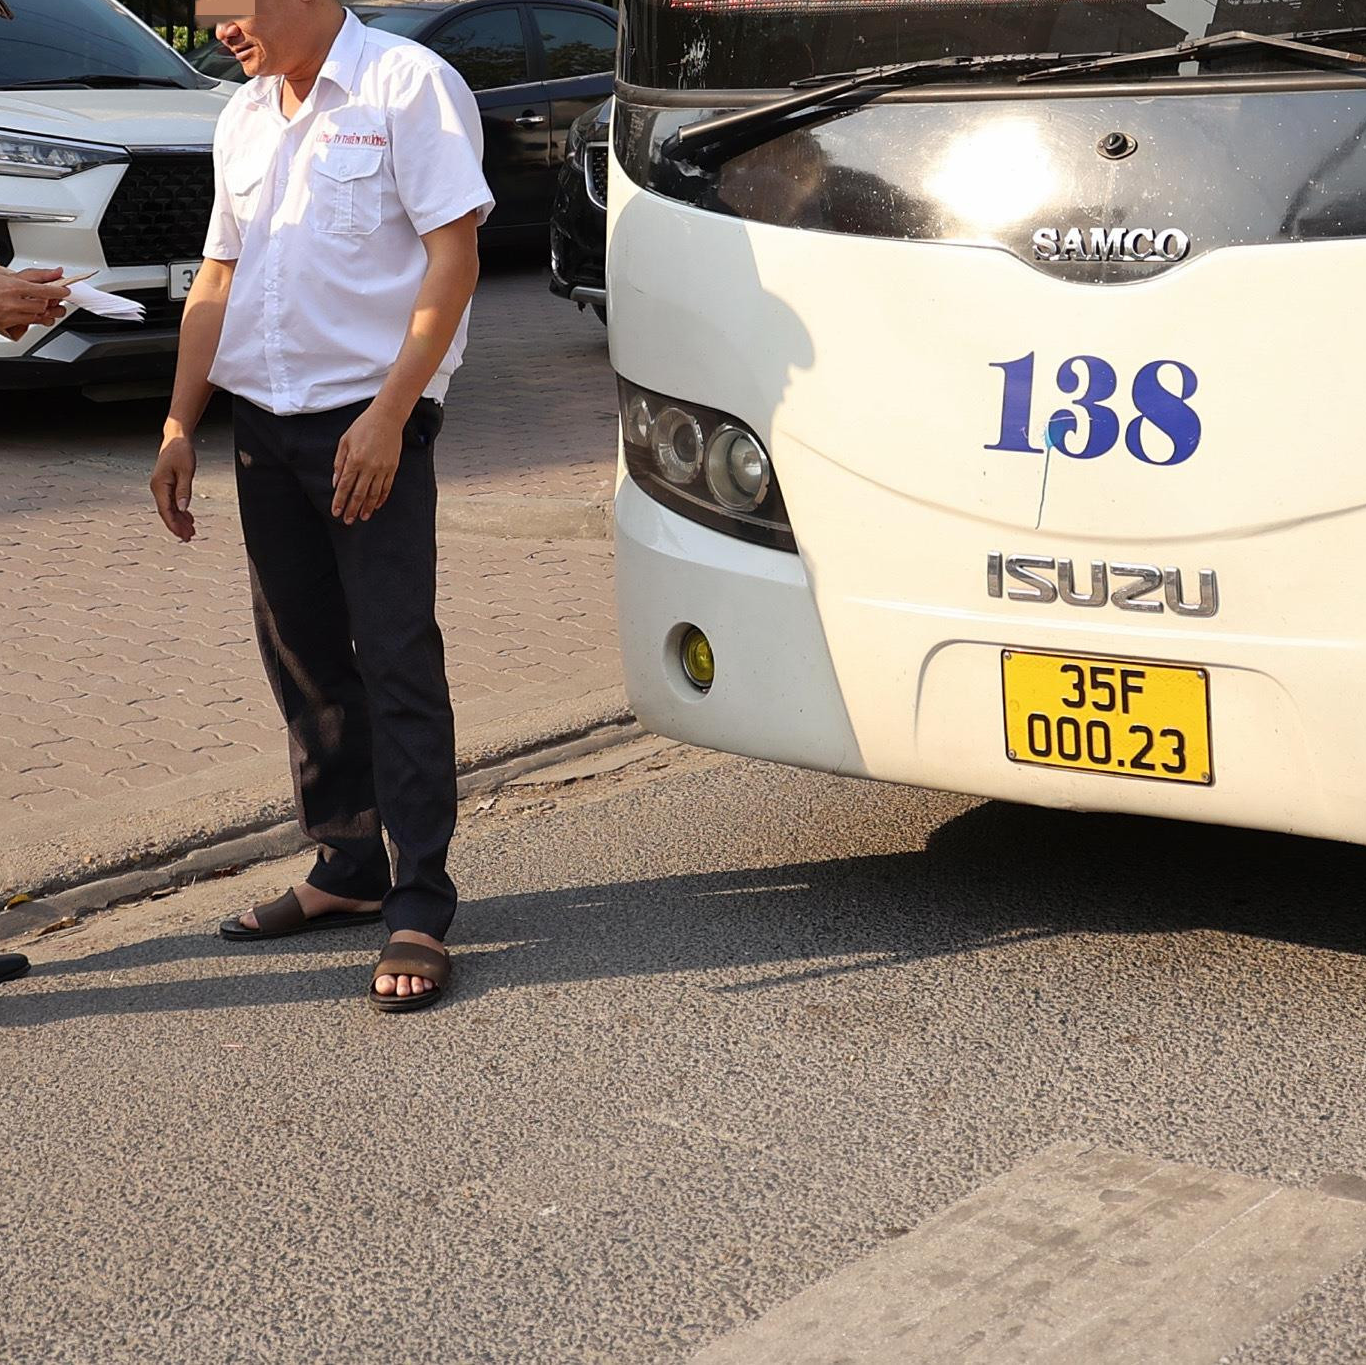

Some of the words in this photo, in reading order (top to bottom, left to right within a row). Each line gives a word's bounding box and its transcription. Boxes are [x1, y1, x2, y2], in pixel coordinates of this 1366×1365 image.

[1032, 226, 1191, 263] SAMCO
[983, 350, 1202, 467] 138
[986, 549, 1220, 618] ISUZU
[1059, 663, 1146, 716] 35F
[1026, 712, 1188, 775] 000.23
